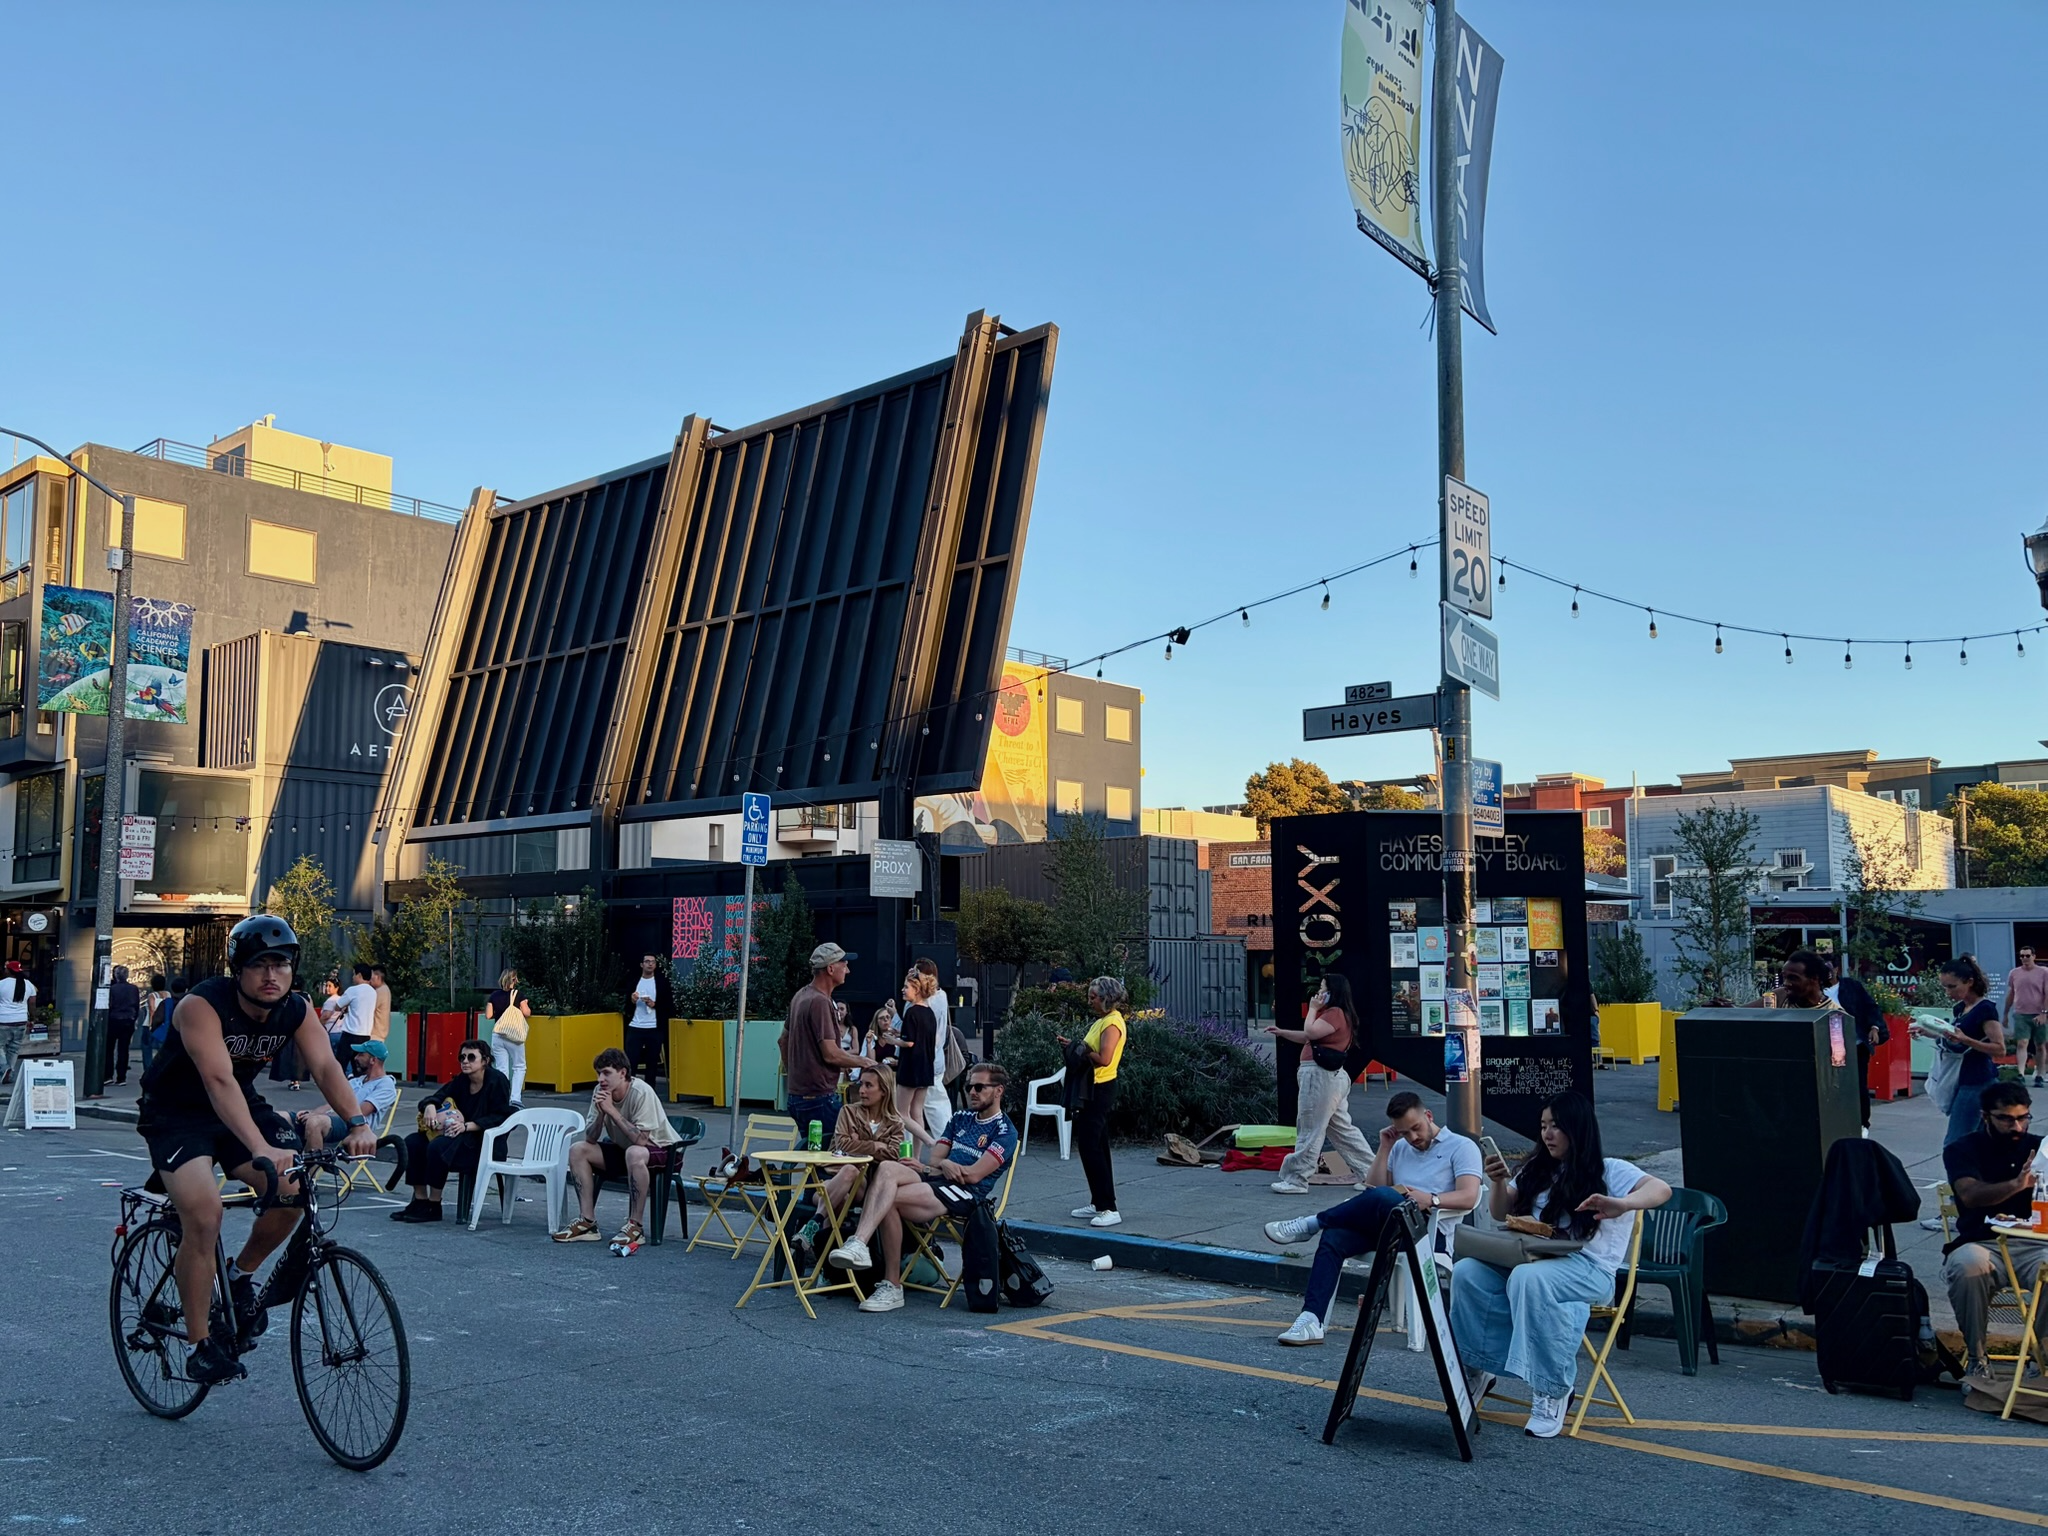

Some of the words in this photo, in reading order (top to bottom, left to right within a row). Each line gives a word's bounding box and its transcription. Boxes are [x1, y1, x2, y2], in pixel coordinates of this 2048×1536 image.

[1378, 80, 1396, 104] may
[1450, 492, 1487, 527] SPEED
[1454, 520, 1483, 551] LIMIT
[1452, 548, 1487, 602] 20
[136, 629, 179, 641] CALIFORNIA
[136, 636, 169, 646] ACADEMY
[169, 640, 179, 648] OF
[136, 643, 178, 657] SCIENCES
[1460, 633, 1478, 669] ONE
[1478, 643, 1496, 678] WAY
[1350, 685, 1376, 700] 482
[1331, 708, 1402, 731] Hayes
[350, 742, 394, 759] AET
[1484, 763, 1493, 780] by
[123, 815, 133, 825] NO
[743, 821, 768, 834] PARKING
[747, 832, 763, 844] ONLY
[1380, 834, 1442, 853] HAYES
[121, 848, 132, 858] NO
[132, 851, 153, 859] STOPPING
[743, 854, 752, 863] FINE
[1232, 856, 1248, 865] SAN
[1250, 855, 1272, 865] FRAN
[873, 860, 913, 875] PROXY
[1380, 853, 1494, 871] COMMUY
[673, 896, 707, 913] PROXY
[673, 911, 713, 929] SPRING
[672, 927, 713, 943] SERIES
[672, 942, 699, 959] 2026
[1485, 1057, 1520, 1066] BROUGHT
[1524, 1057, 1535, 1066] TO
[1538, 1057, 1554, 1066] YOU
[1518, 1065, 1540, 1073] AYES
[1486, 1086, 1531, 1095] MERCHANTS
[1496, 1079, 1511, 1088] THE
[1515, 1079, 1541, 1088] HAYES
[1544, 1079, 1574, 1088] VALLEY
